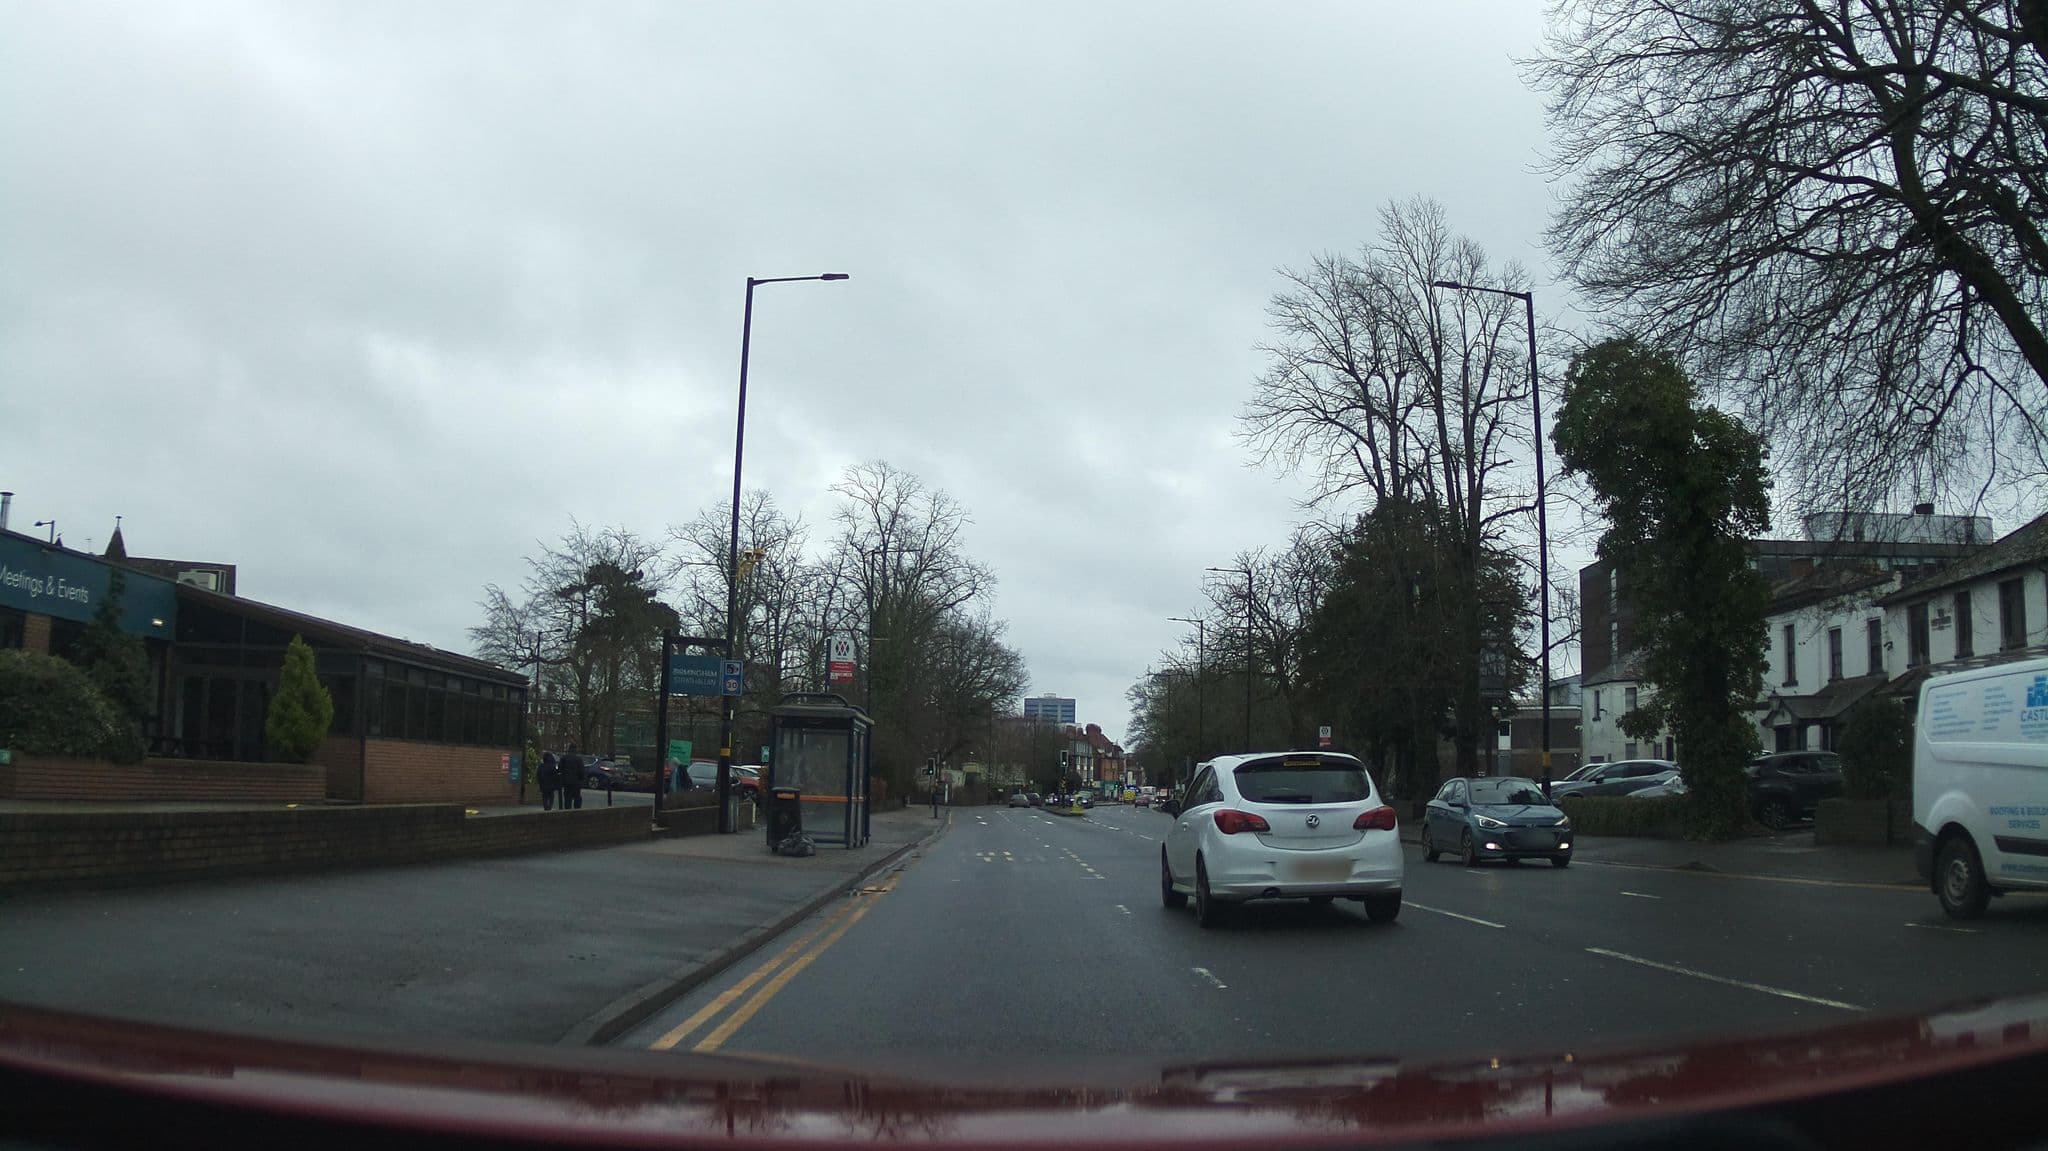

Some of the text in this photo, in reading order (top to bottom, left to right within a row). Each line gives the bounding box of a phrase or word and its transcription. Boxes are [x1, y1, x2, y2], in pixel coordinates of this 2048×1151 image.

[46, 575, 56, 595] &
[58, 578, 89, 603] Events
[727, 681, 738, 689] 30
